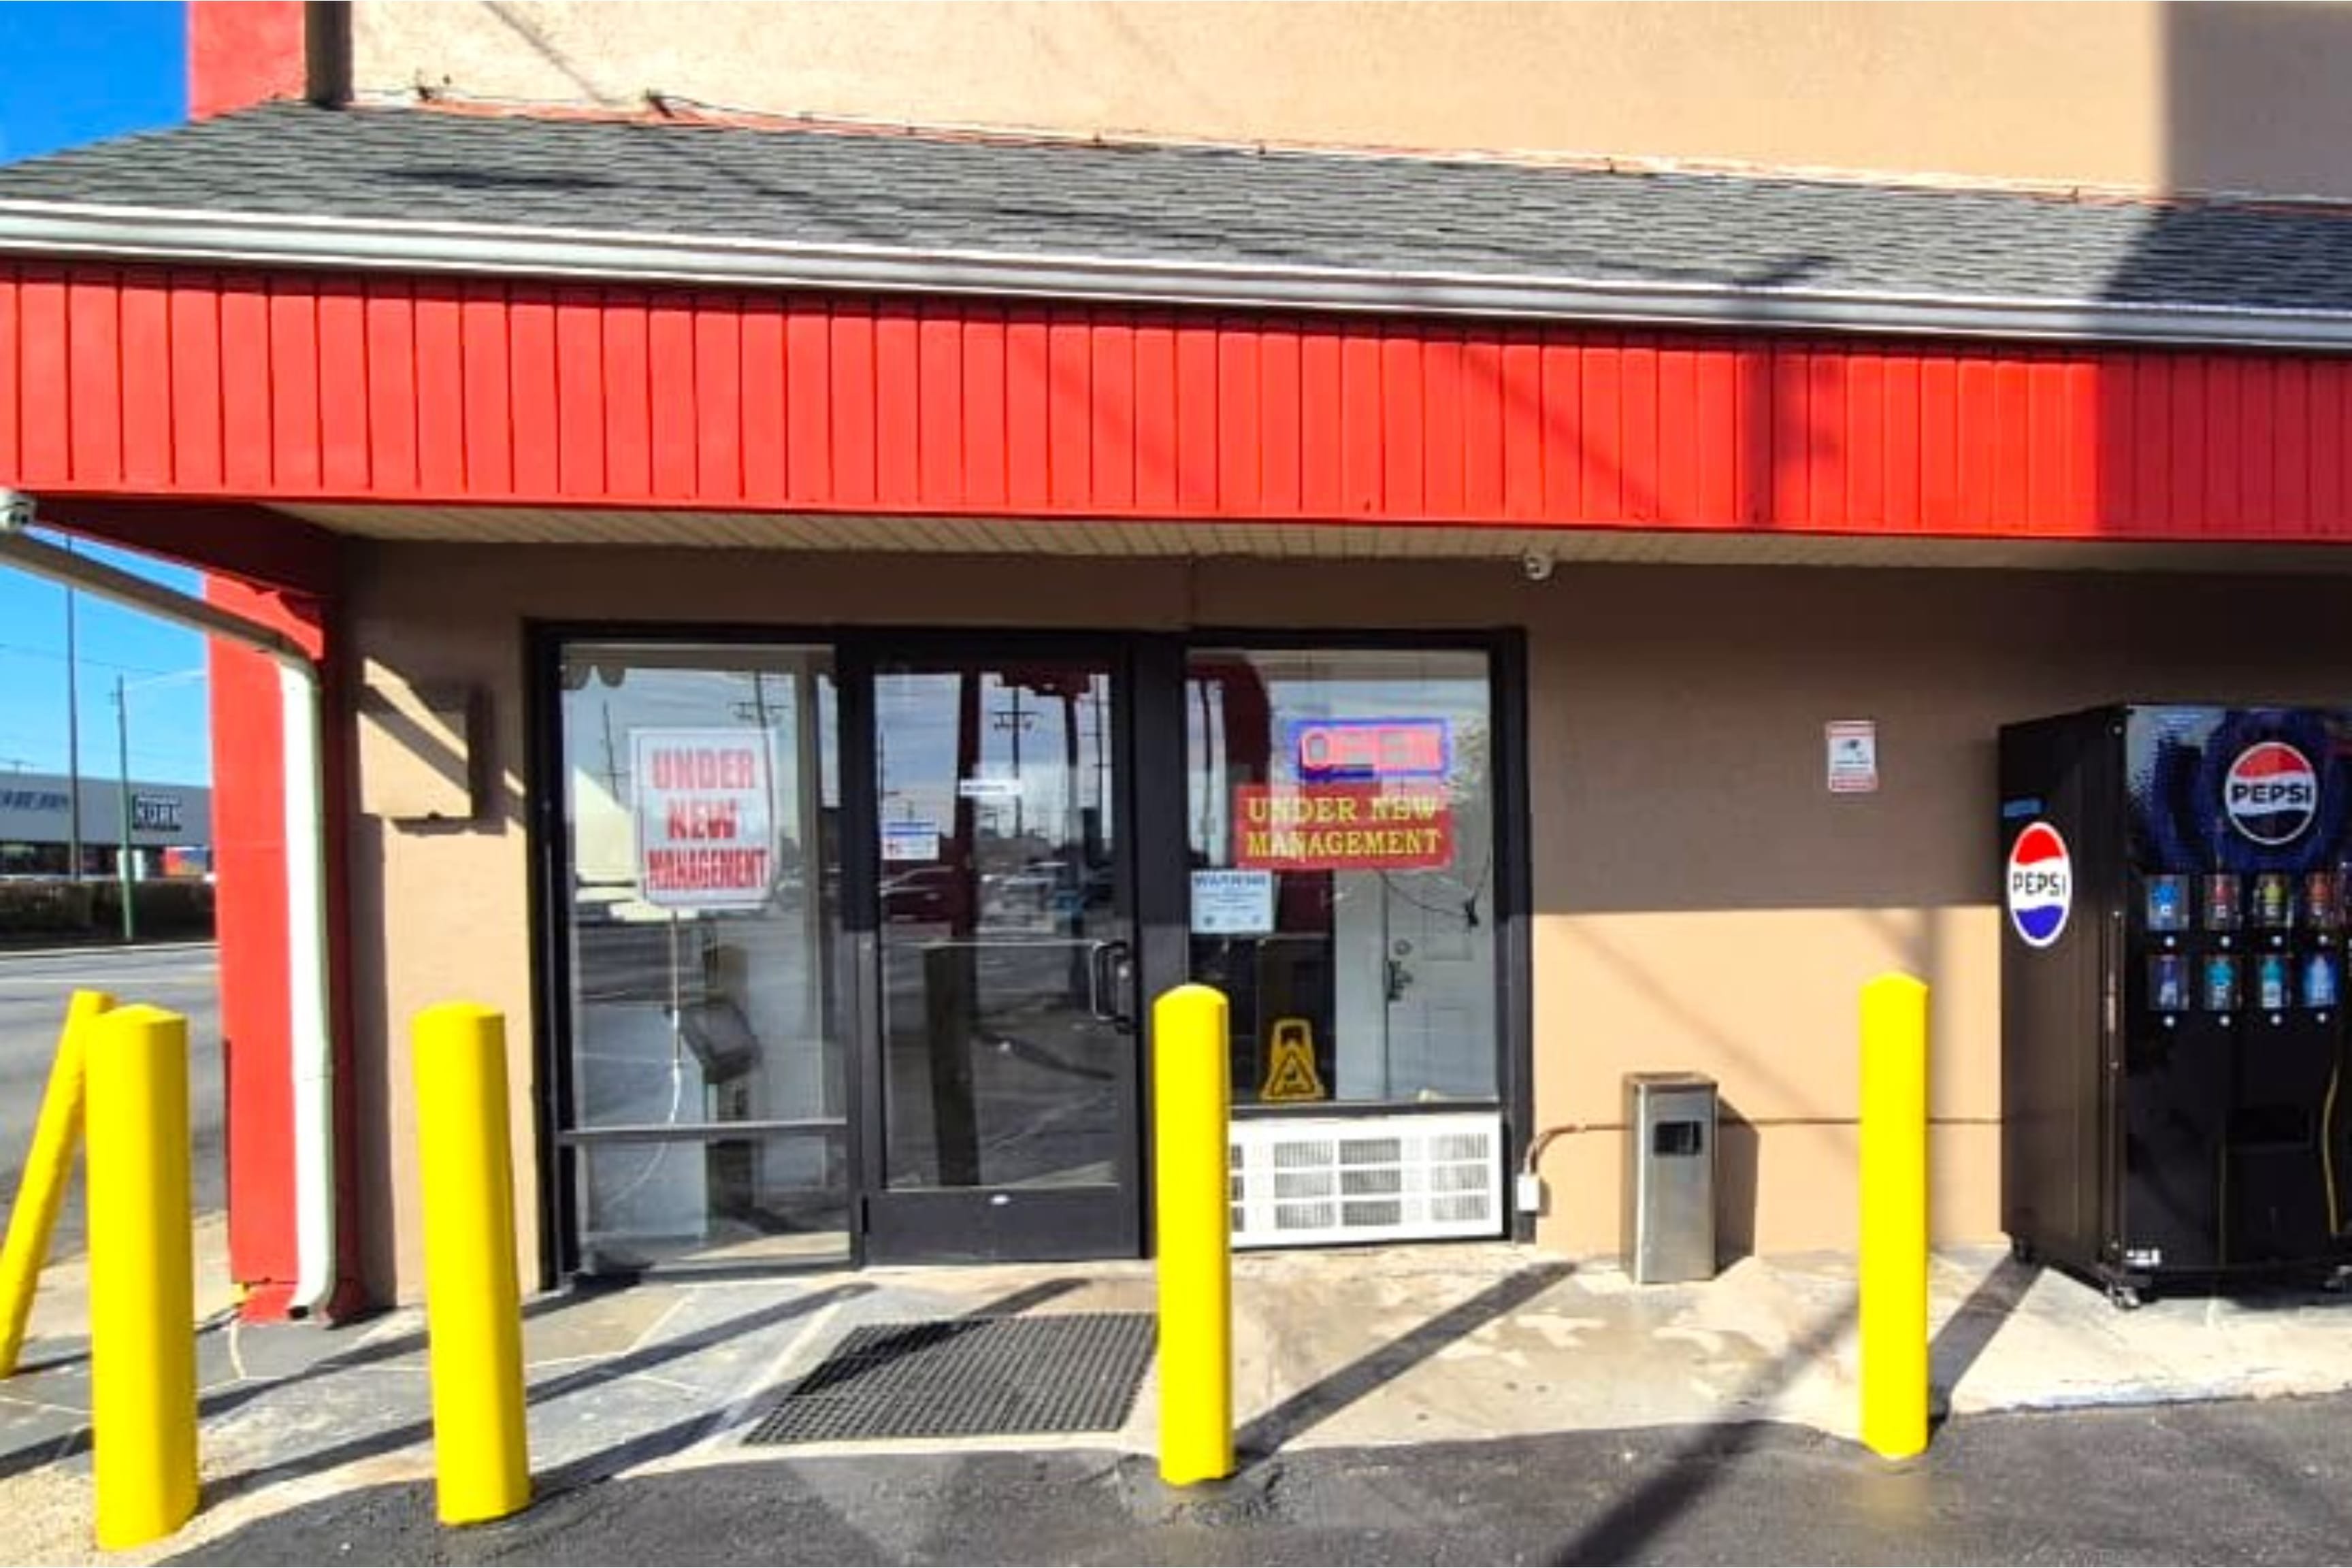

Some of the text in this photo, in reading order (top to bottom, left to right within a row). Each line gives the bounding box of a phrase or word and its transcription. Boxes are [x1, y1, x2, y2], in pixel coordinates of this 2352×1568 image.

[652, 748, 755, 788] UNDER
[2232, 782, 2310, 804] PEPSI
[668, 798, 737, 839] NEW
[1247, 795, 1439, 824] UNDER NEW
[1246, 828, 1442, 859] MANAGEMENT
[649, 847, 767, 890] MANAGEMENT
[2012, 871, 2066, 897] PEPSI
